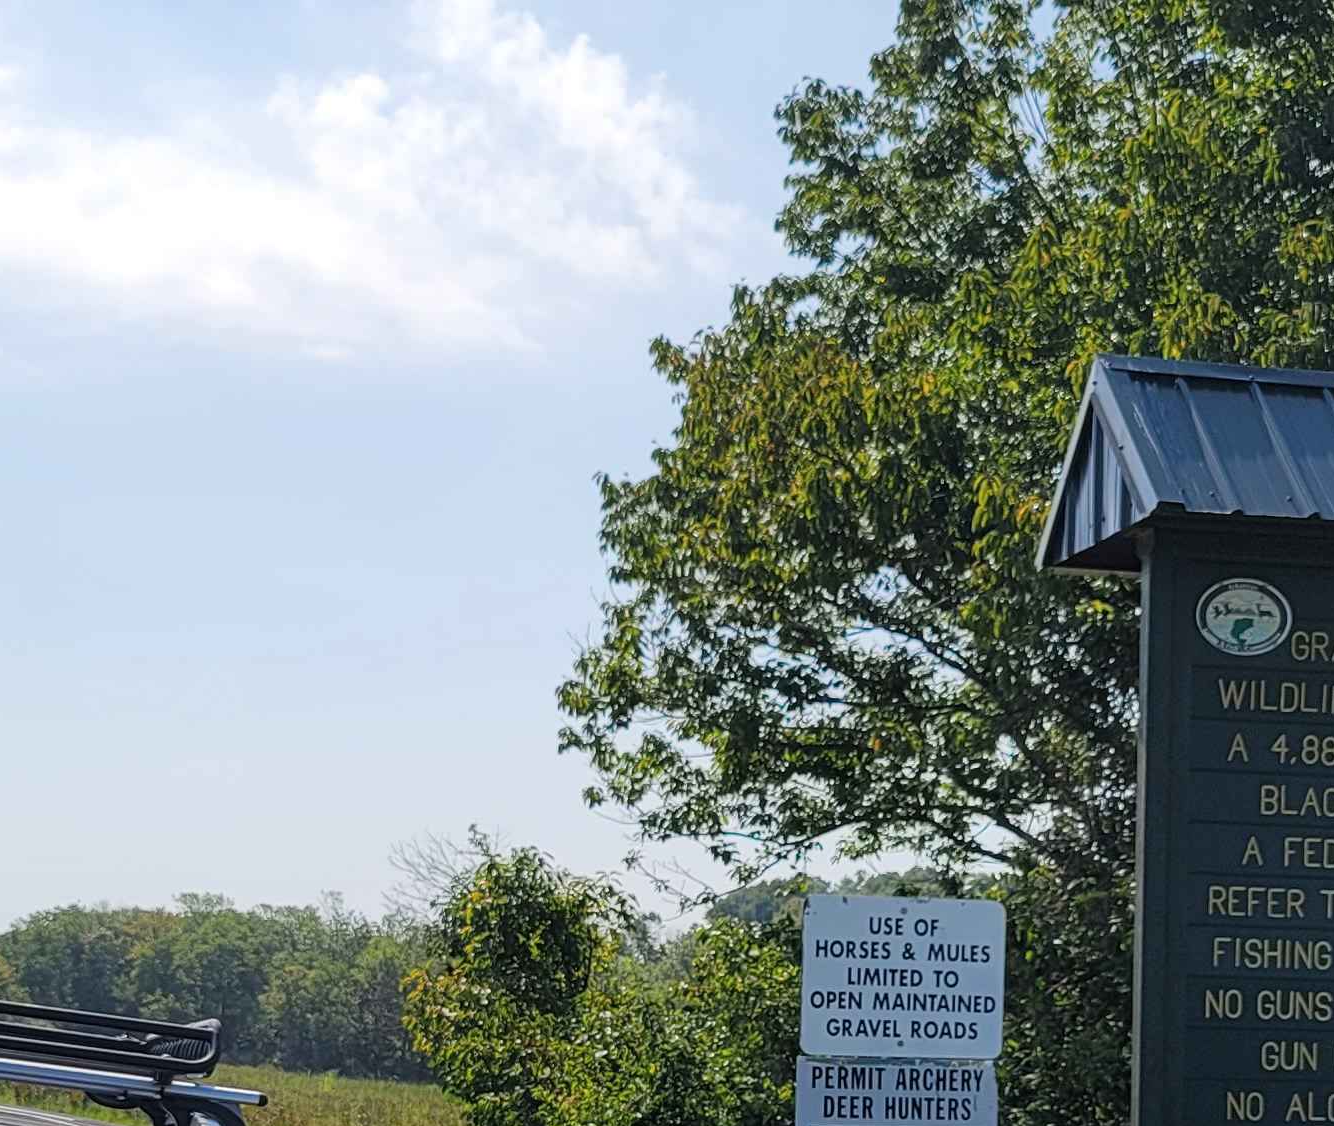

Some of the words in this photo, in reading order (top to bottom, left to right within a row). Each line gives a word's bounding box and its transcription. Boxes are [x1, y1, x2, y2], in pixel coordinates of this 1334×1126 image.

[1227, 732, 1249, 763] A
[1242, 836, 1263, 866] A
[1207, 887, 1305, 919] REFER
[868, 917, 904, 936] USE
[914, 918, 940, 937] OF
[815, 940, 891, 960] HORSES
[902, 943, 916, 960] &
[928, 944, 991, 964] MULES
[1212, 937, 1332, 971] FISHING
[847, 967, 923, 988] LIMITED
[933, 970, 959, 988] TO
[810, 991, 863, 1010] OPEN
[872, 993, 996, 1014] MAINTAINED
[1204, 990, 1243, 1020] NO
[1257, 991, 1332, 1022] GUNS
[826, 1018, 902, 1039] GRAVEL
[910, 1020, 979, 1040] ROADS
[1260, 1041, 1318, 1072] GUN
[811, 1066, 886, 1090] PERMIT
[895, 1068, 984, 1092] ARCHERY
[823, 1095, 874, 1120] DEER
[885, 1097, 972, 1121] HUNTERS
[1226, 1091, 1264, 1121] NO
